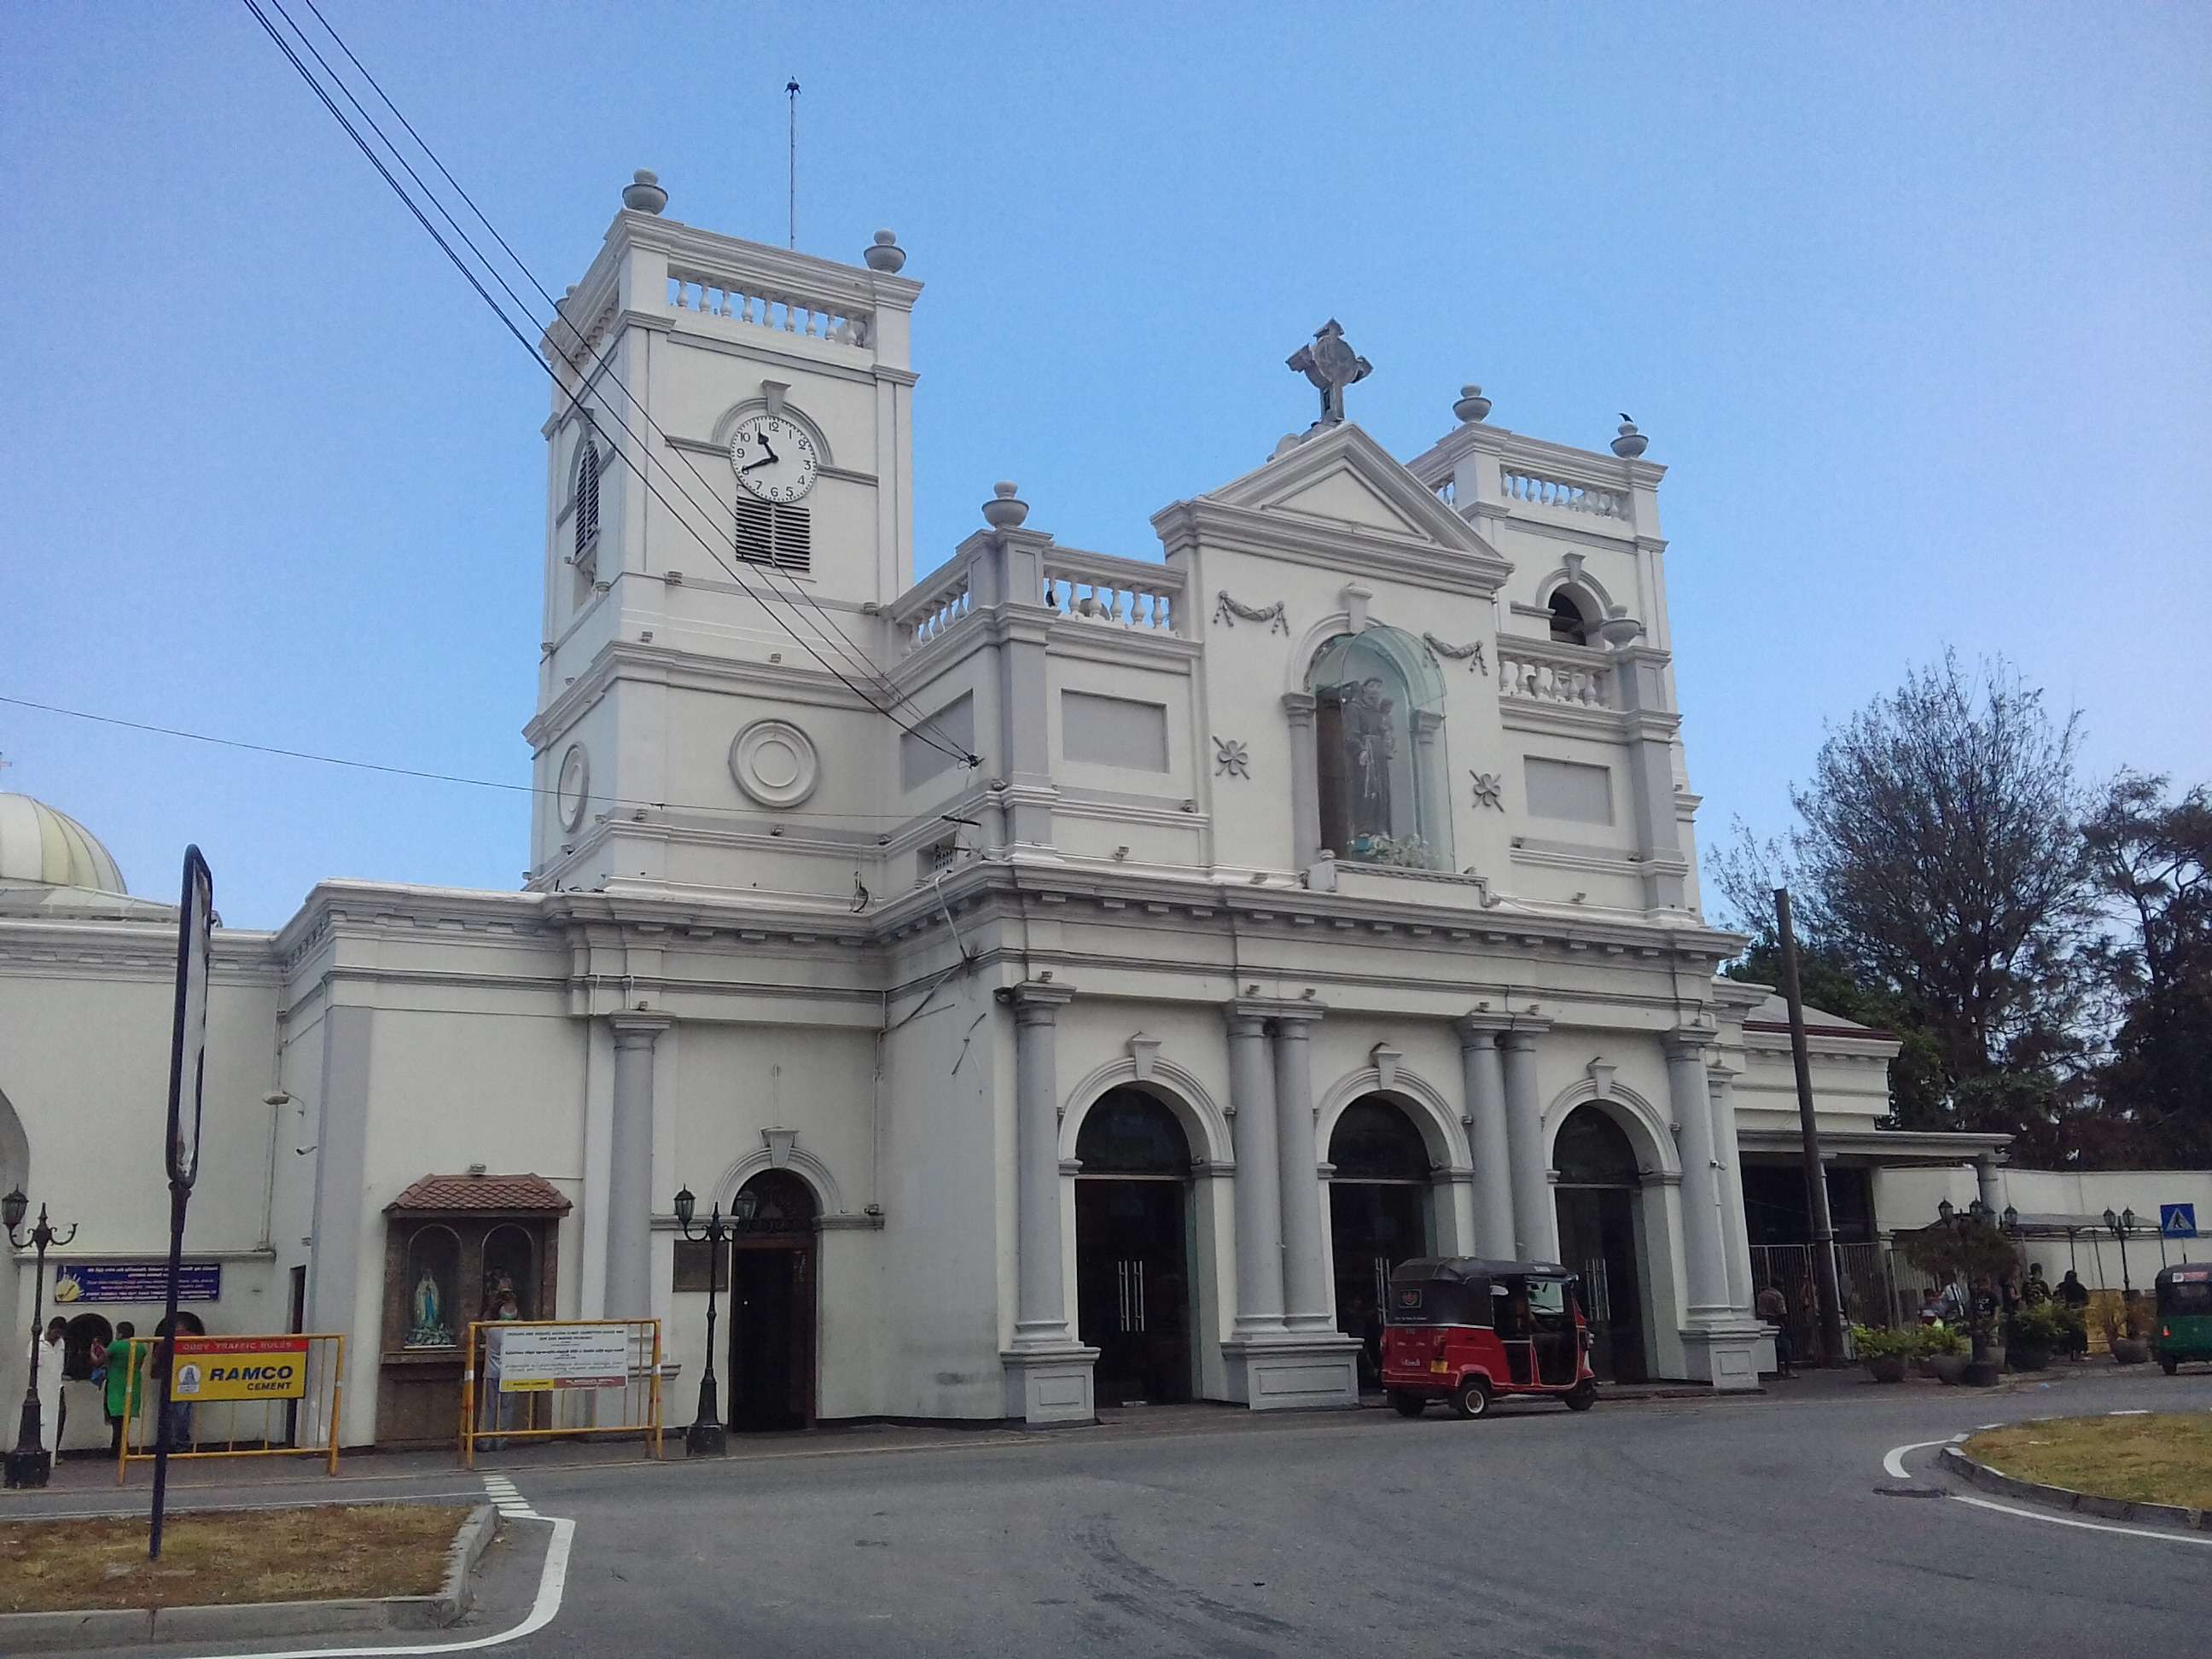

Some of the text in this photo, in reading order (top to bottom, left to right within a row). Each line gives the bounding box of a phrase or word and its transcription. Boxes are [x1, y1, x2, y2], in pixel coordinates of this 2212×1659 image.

[769, 422, 779, 432] 12
[740, 433, 750, 442] 10
[798, 439, 806, 451] 2
[736, 448, 745, 458] 9
[803, 459, 812, 470] 3
[797, 475, 806, 485] 4
[754, 480, 763, 491] 7
[770, 487, 778, 498] 6
[785, 486, 794, 497] 5
[216, 1341, 257, 1350] TRAFFIC
[260, 1340, 293, 1349] RULES
[209, 1365, 294, 1382] RAMCO
[247, 1382, 293, 1391] CEMENT
